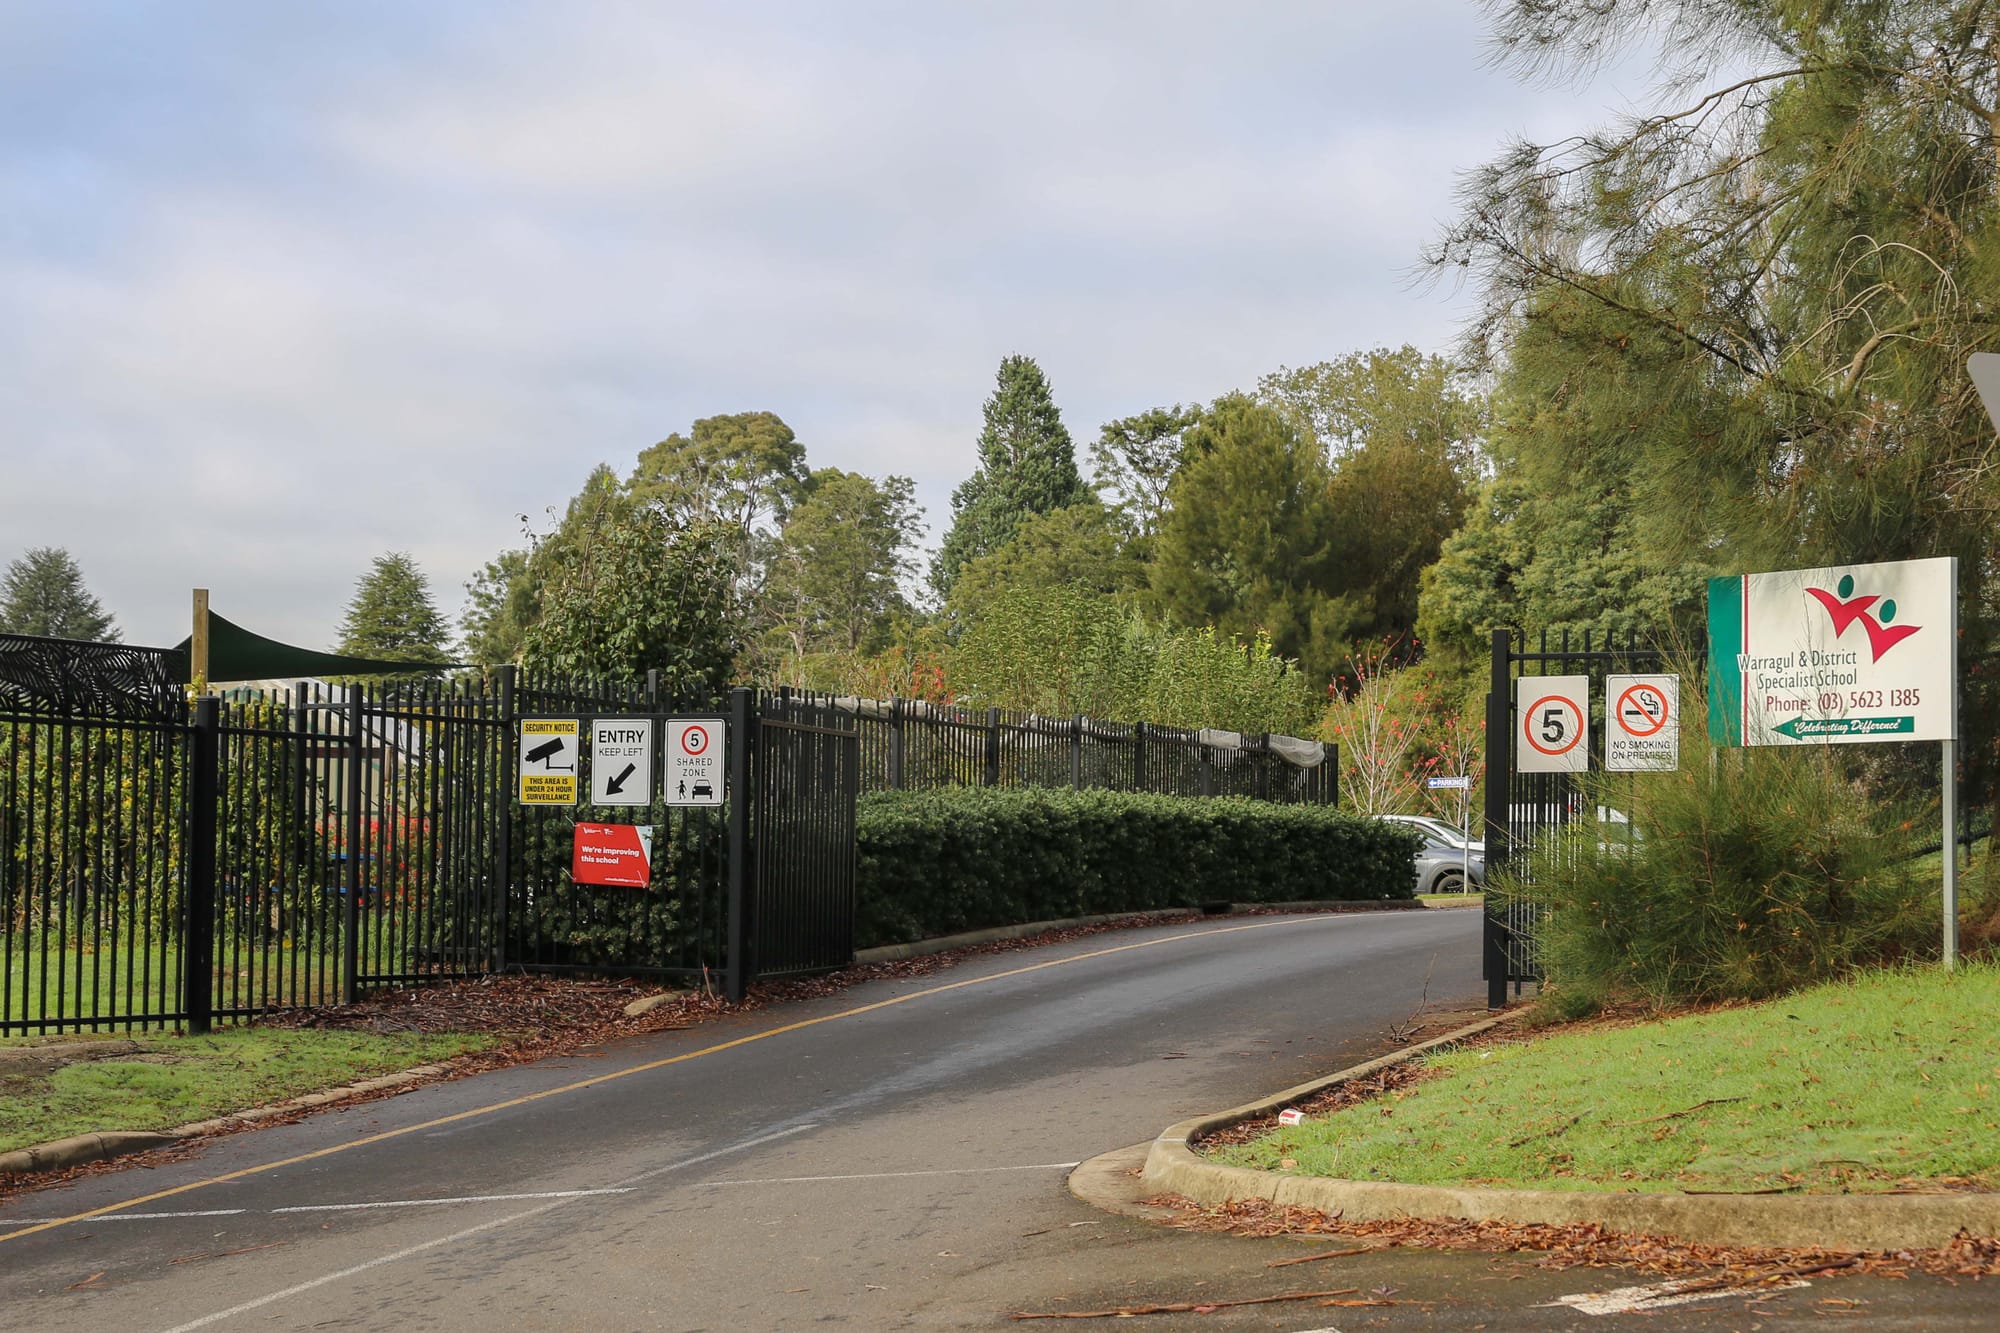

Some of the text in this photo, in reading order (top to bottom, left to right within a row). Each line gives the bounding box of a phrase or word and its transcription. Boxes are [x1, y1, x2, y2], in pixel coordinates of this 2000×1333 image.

[1737, 650, 1857, 673] Warragul & District
[1758, 668, 1857, 694] Specialist School
[1766, 688, 1920, 714] Phone: (03) 5623 1385
[526, 724, 575, 732] SECURITY NOTICE
[1542, 709, 1564, 743] 5
[599, 730, 644, 743] ENTRY
[690, 734, 699, 747] 5
[1613, 740, 1670, 749] NO SMOKING
[599, 748, 643, 756] KEEP LEFT
[1612, 751, 1672, 760] ON PREMISES
[676, 758, 712, 766] SHARED
[603, 847, 640, 857] improving
[596, 856, 619, 864] school
